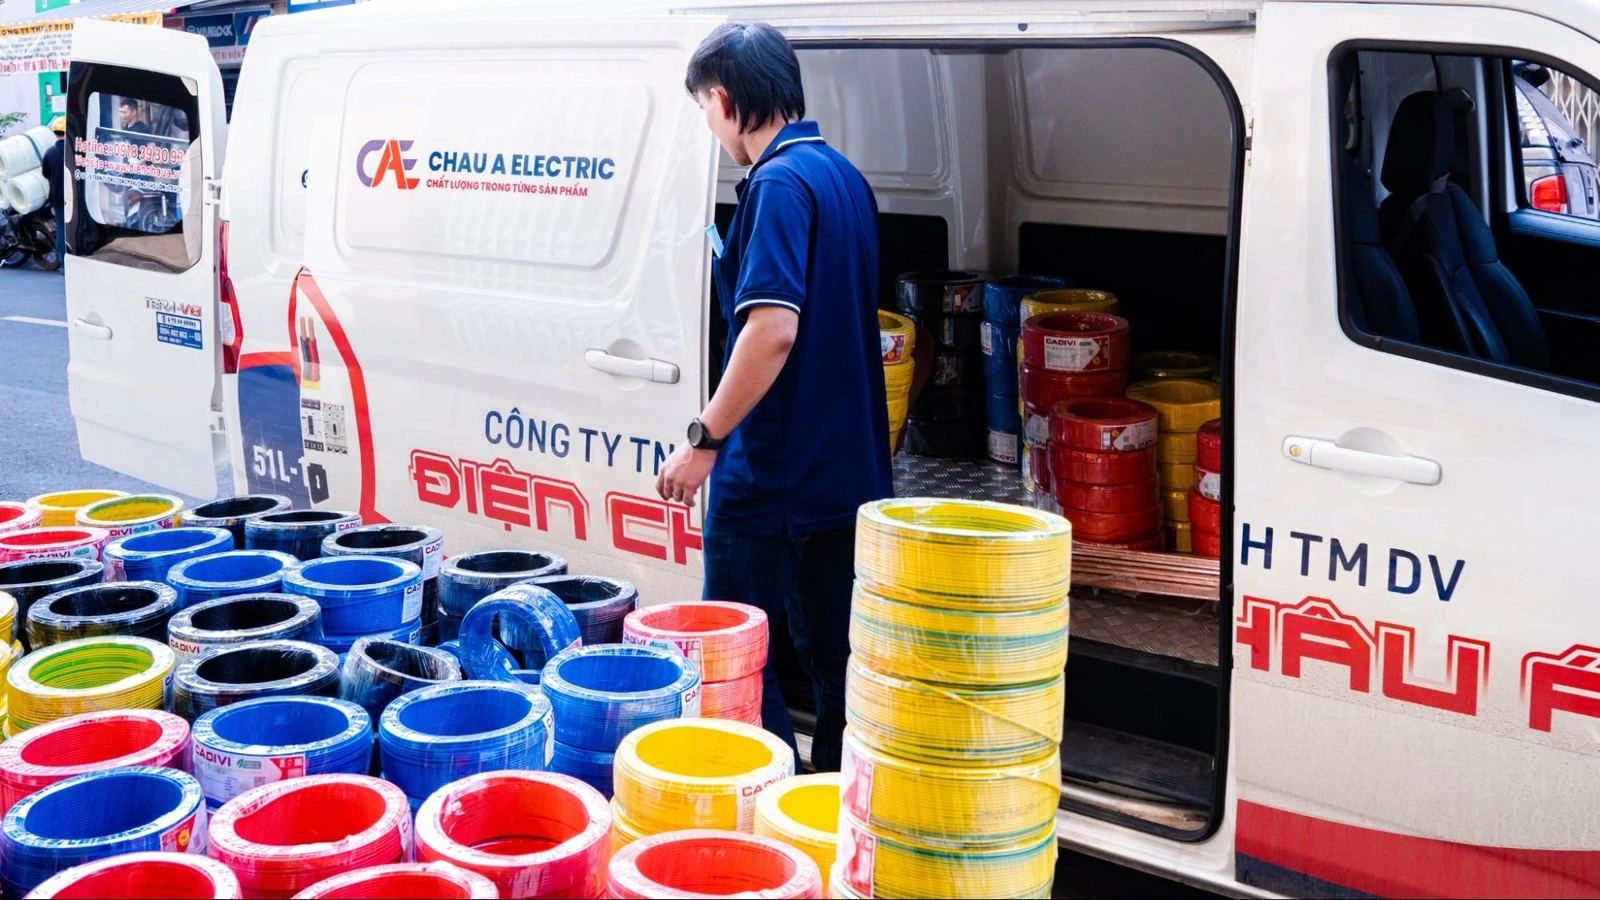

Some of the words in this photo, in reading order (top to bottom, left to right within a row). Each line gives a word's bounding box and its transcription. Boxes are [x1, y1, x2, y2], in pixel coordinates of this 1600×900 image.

[113, 143, 138, 159] 0918
[140, 146, 153, 162] 39
[154, 148, 169, 164] 30
[428, 151, 488, 175] CHAU
[490, 153, 506, 175] A
[511, 154, 615, 180] ELECTRIC
[426, 175, 449, 189] CHẤT
[450, 180, 479, 194] LƯỢNG
[480, 182, 511, 194] TRONG
[512, 181, 537, 195] TỪNG
[538, 183, 558, 197] SẢN
[559, 183, 588, 197] PHẨM
[1045, 338, 1077, 347] CADIVI
[485, 407, 570, 458] CÔNG
[578, 427, 622, 468] TY
[408, 448, 590, 542] ĐIỆN
[1290, 530, 1369, 587] TM
[1387, 547, 1467, 602] DV
[195, 743, 231, 768] CADIVI
